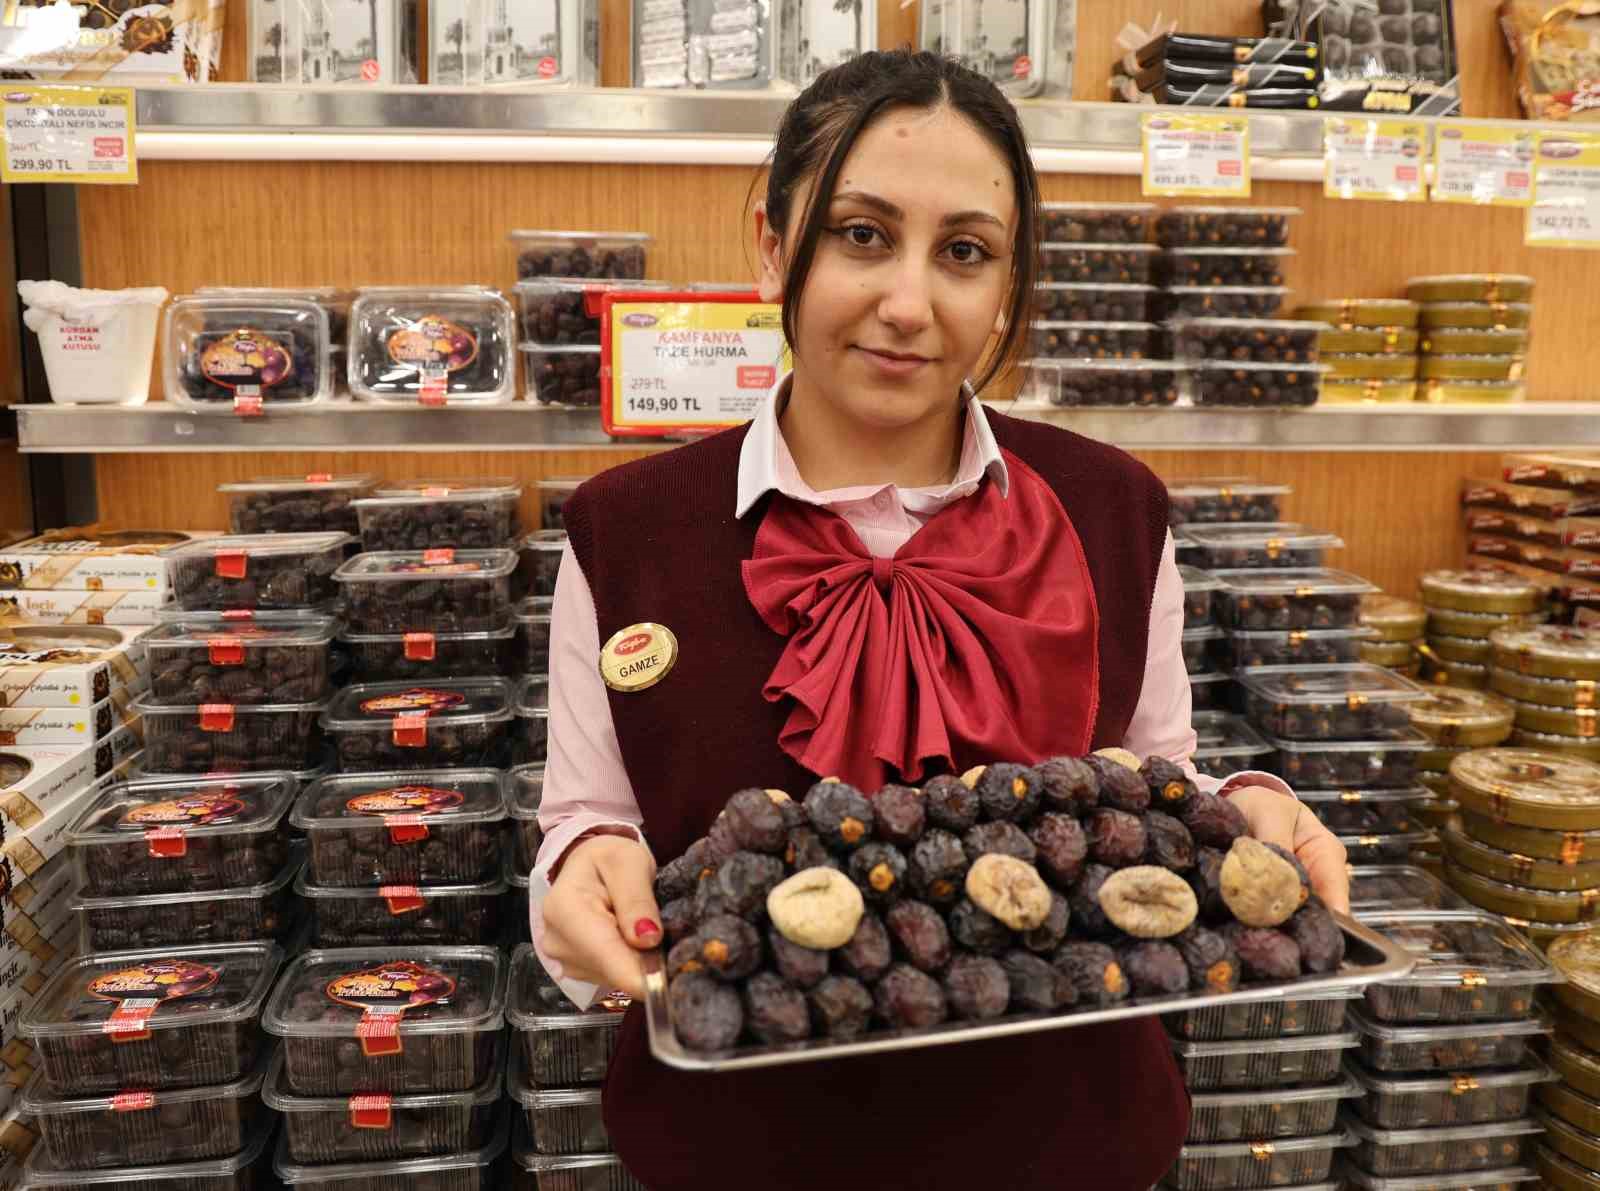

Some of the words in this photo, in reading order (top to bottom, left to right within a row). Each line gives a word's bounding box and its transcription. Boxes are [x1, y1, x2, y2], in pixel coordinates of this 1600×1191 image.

[57, 108, 105, 117] DOLGULU
[56, 159, 72, 170] TL
[694, 346, 748, 358] HURMA
[654, 377, 666, 390] TL
[629, 397, 677, 413] 149,90
[682, 397, 701, 411] TL
[620, 654, 660, 678] GAMZE
